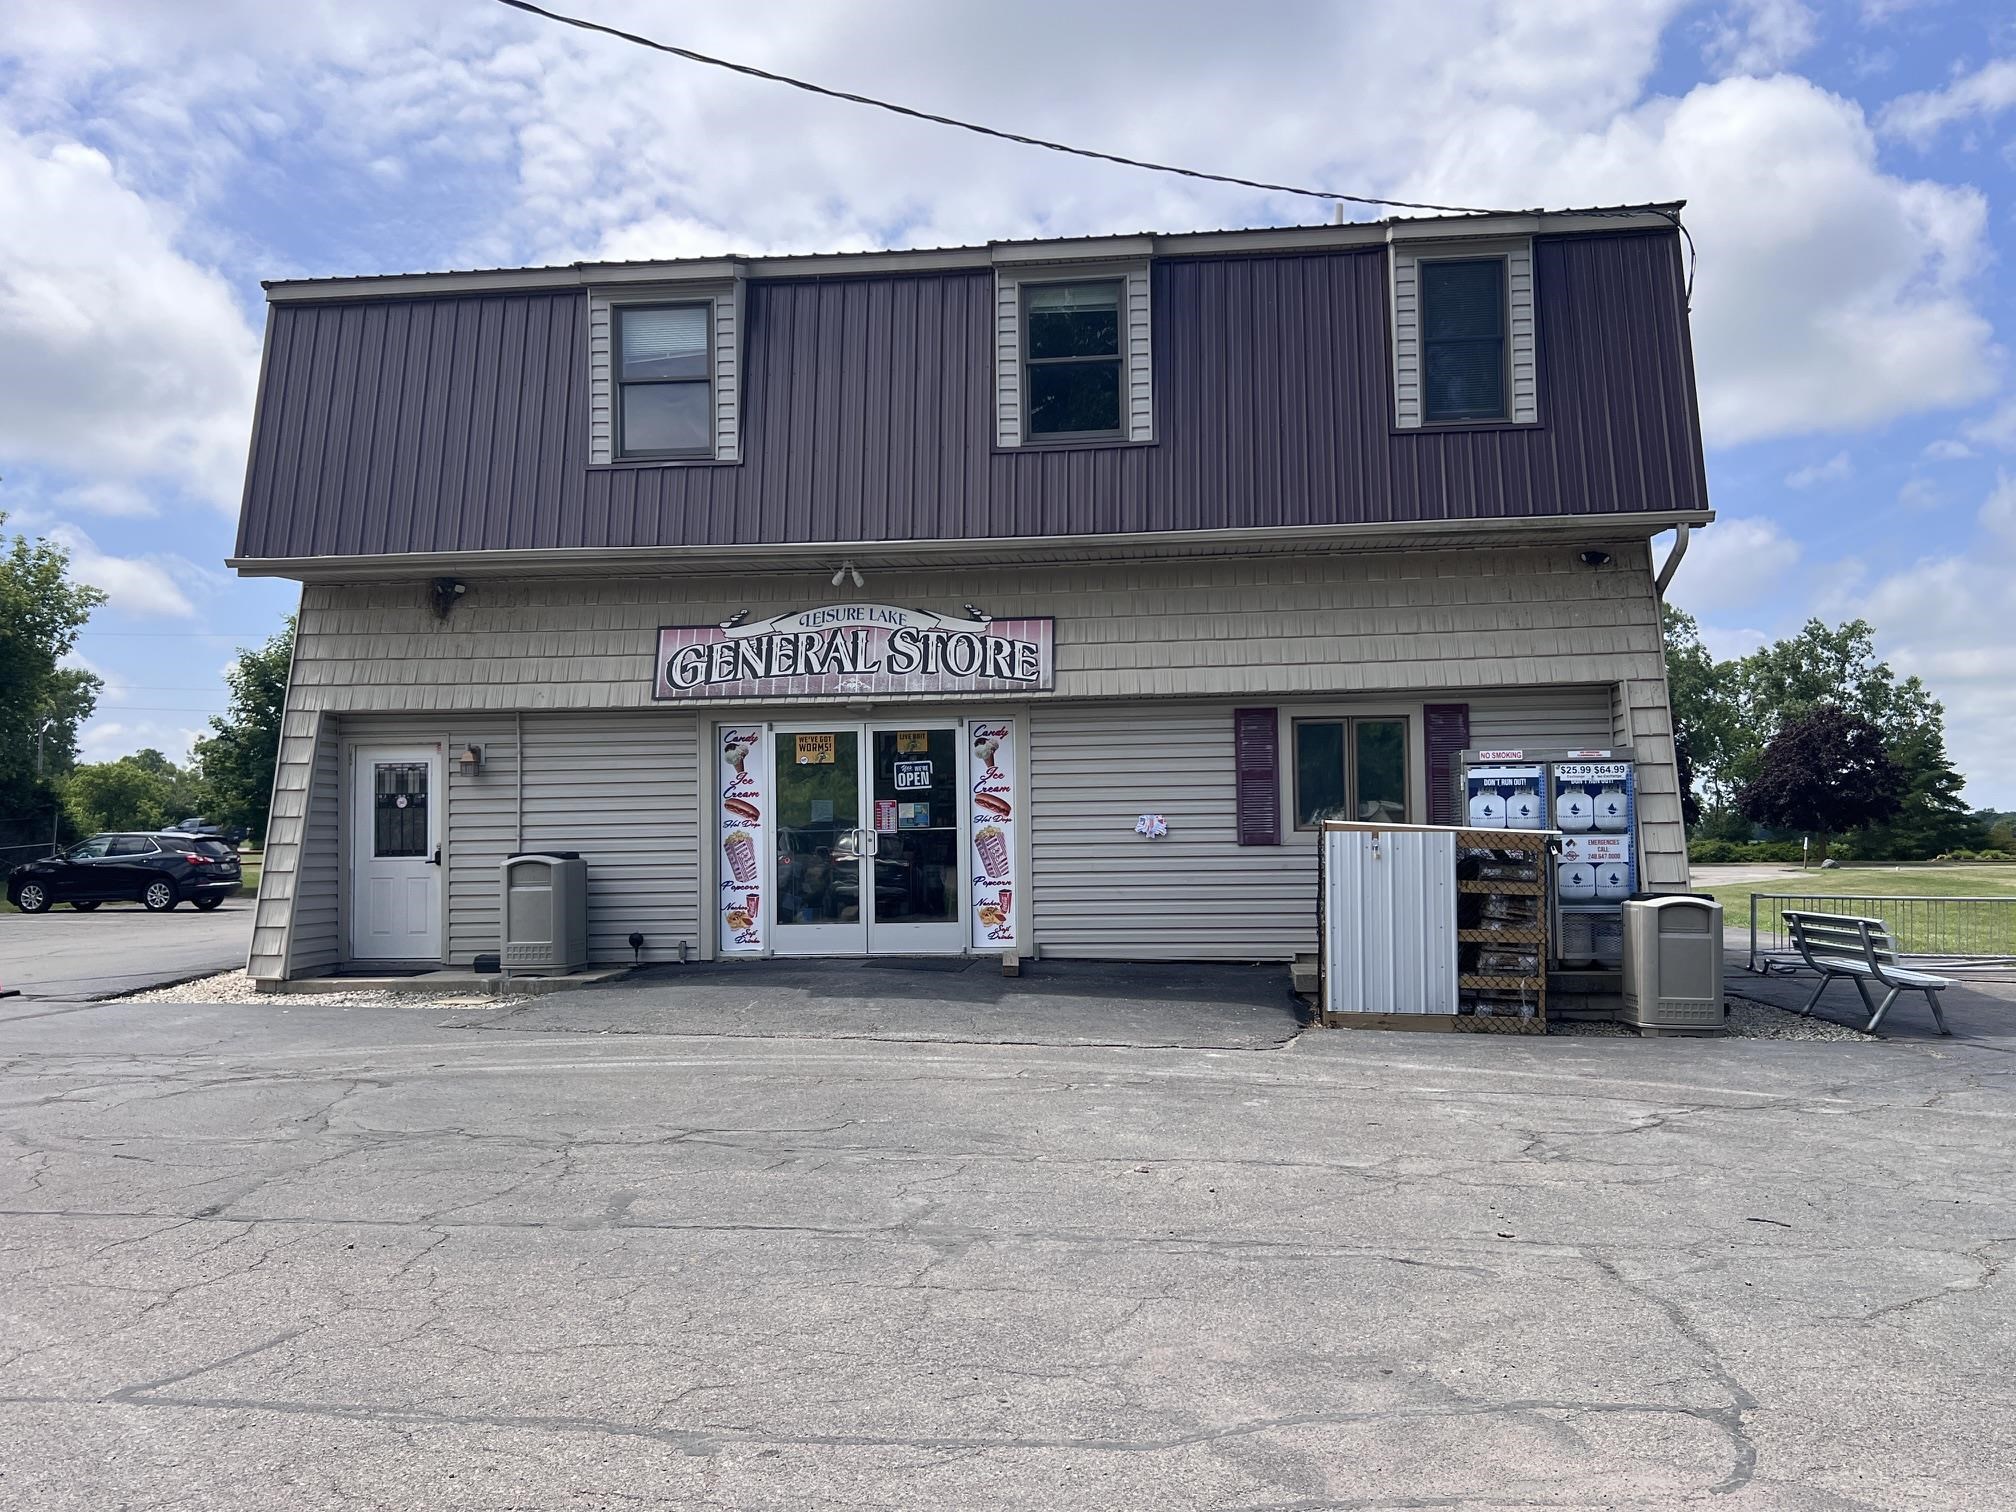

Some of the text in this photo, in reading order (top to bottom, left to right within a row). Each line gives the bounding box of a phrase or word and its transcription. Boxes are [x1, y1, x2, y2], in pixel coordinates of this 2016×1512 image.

[799, 608, 907, 627] LEISURE LAKE
[666, 626, 1040, 690] GENERAL STORE
[723, 729, 759, 745] Candy
[973, 724, 1009, 740] Candy
[799, 742, 832, 752] WORMS!
[1491, 751, 1522, 759] SMOKING
[979, 767, 1005, 781] Ice
[1560, 765, 1625, 775] $25.99 $64.99
[729, 772, 755, 786] Ice
[898, 772, 930, 787] OPEN
[1483, 778, 1527, 786] DON'T RUN OUT!
[723, 785, 760, 799] Cream
[973, 780, 1011, 794] Cream
[721, 880, 760, 893] Popcorn
[972, 876, 1012, 888] Popcorn
